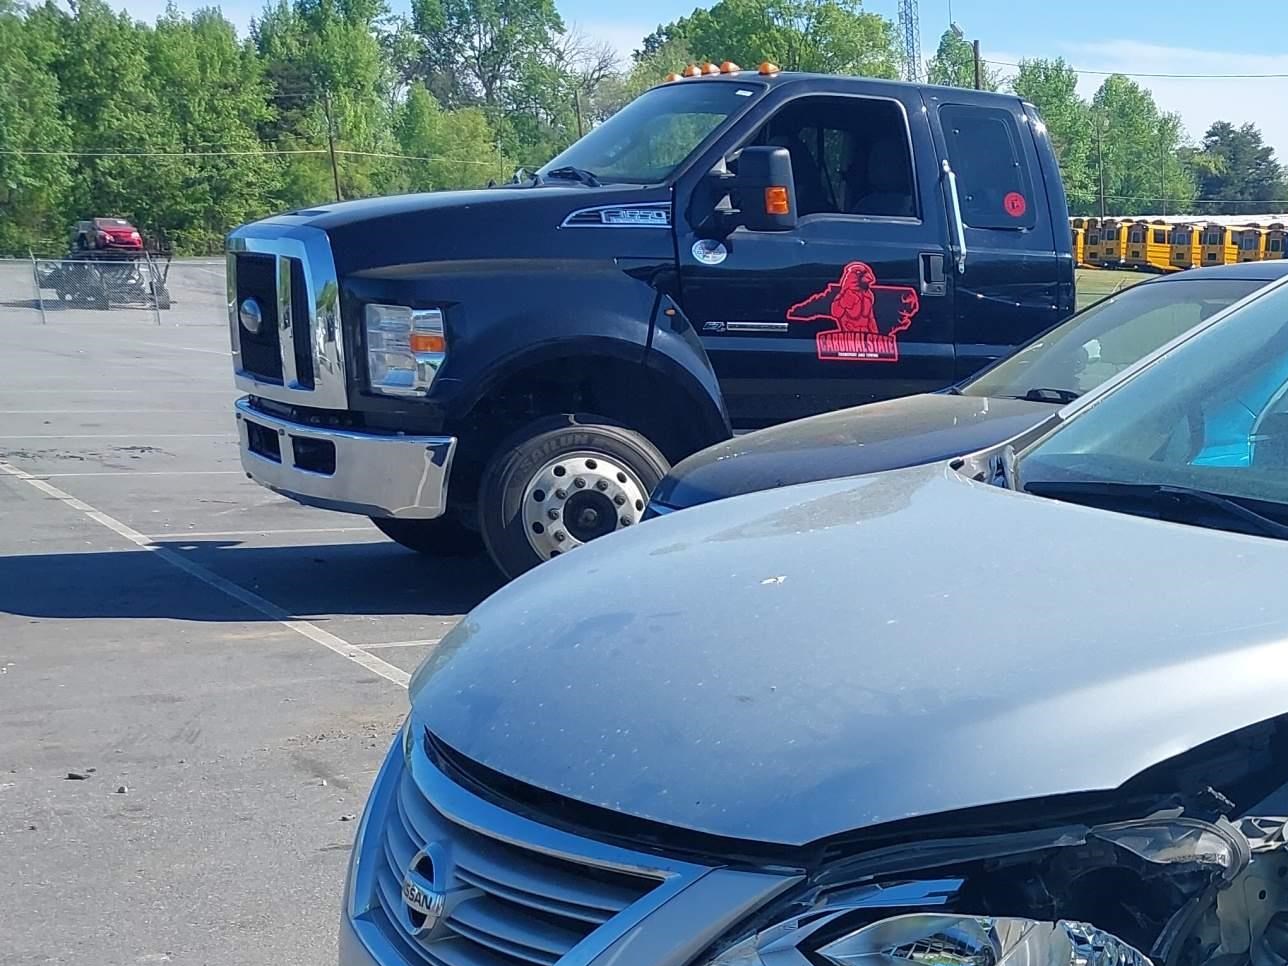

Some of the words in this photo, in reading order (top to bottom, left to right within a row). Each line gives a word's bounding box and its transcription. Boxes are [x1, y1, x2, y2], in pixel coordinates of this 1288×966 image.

[820, 333, 867, 352] CARDINAL
[867, 334, 895, 354] STATE
[403, 882, 433, 910] SSAN
